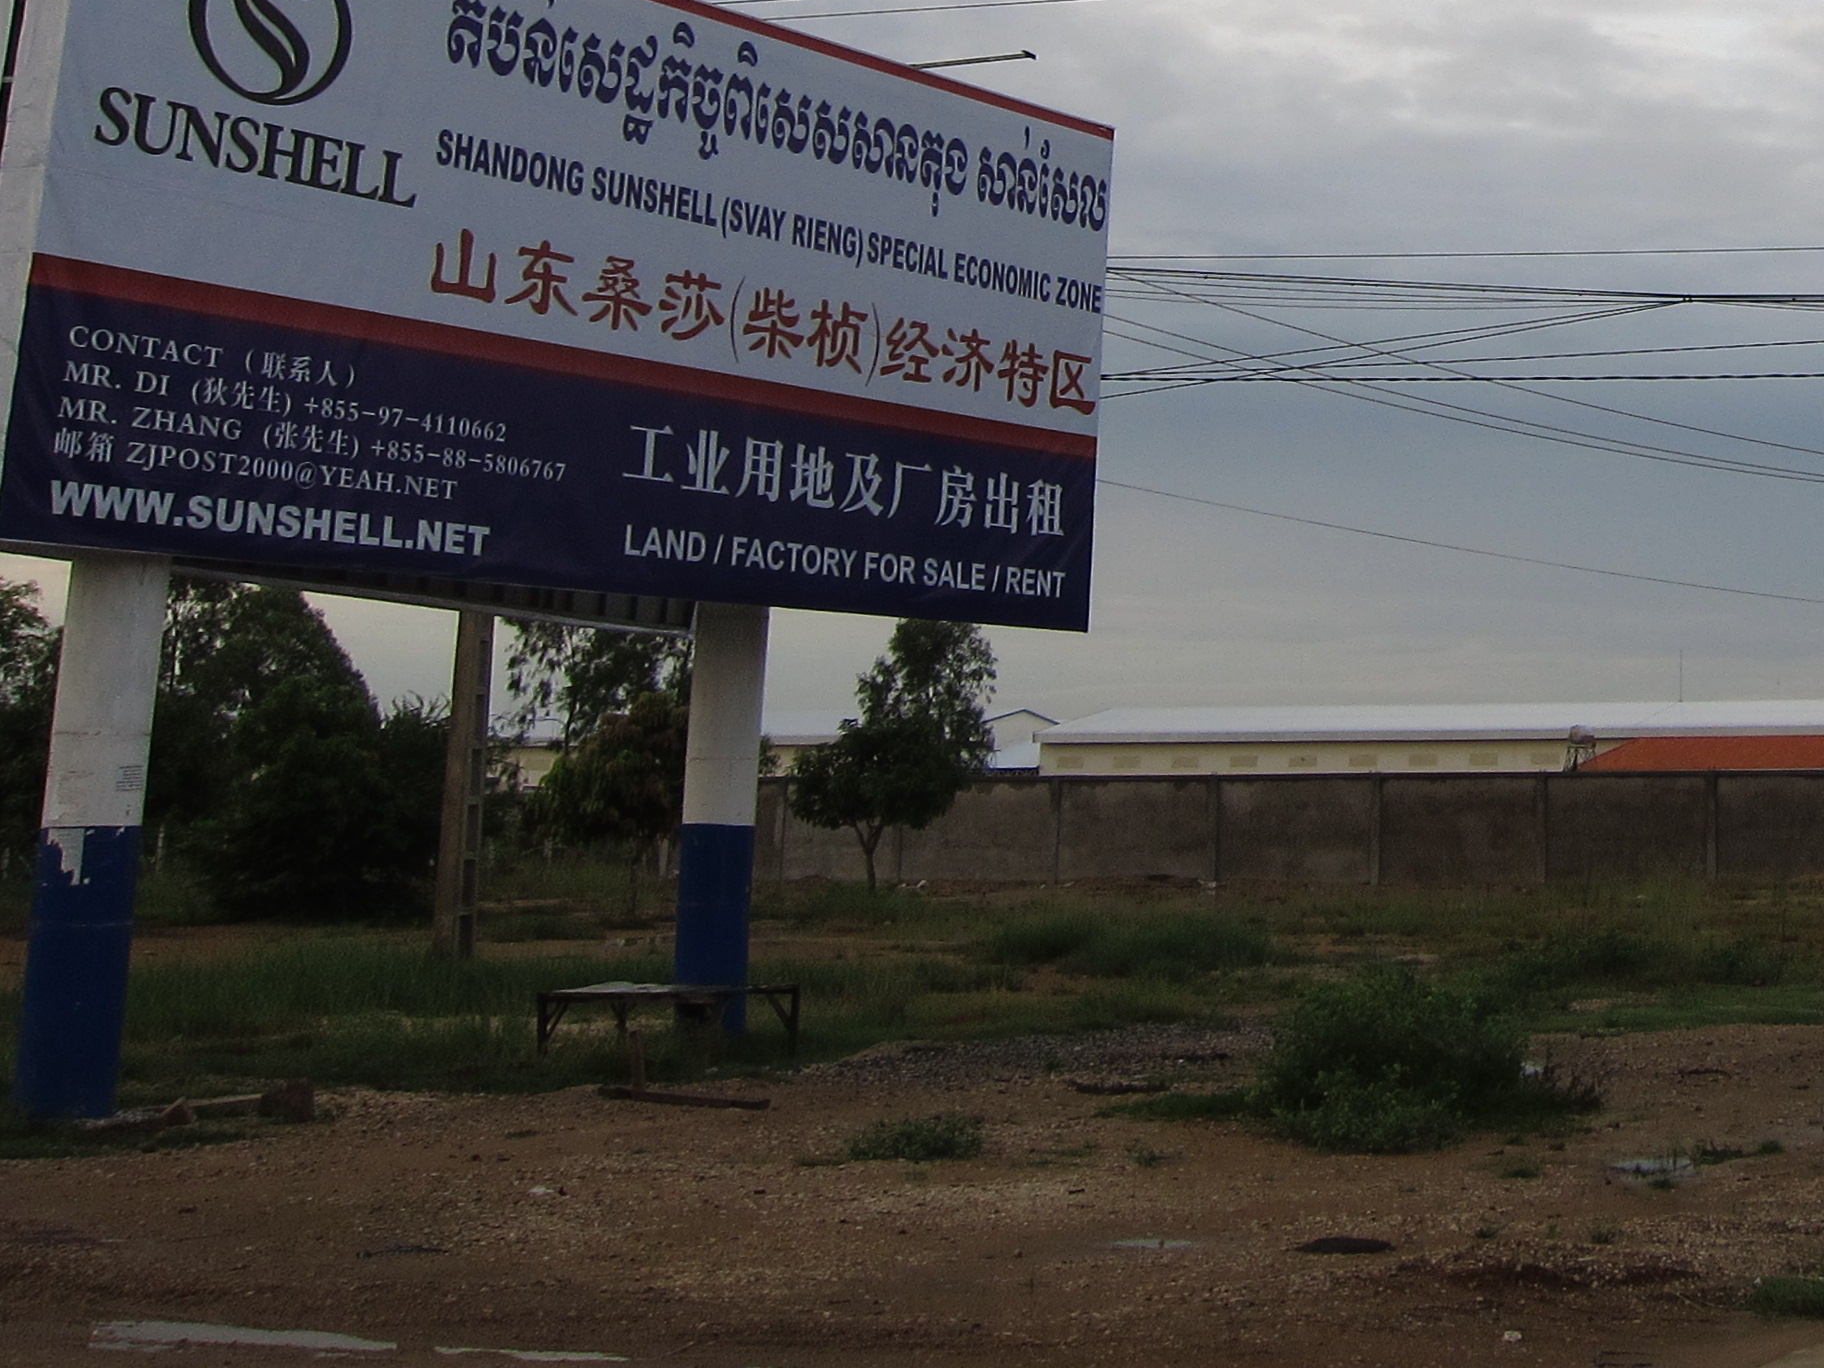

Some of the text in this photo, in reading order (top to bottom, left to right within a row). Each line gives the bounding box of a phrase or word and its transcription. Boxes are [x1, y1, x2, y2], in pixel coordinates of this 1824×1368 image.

[94, 87, 417, 208] SUNSHELL
[436, 129, 1102, 314] SHANDONG SUNSHELL (SVAY RIENG) SPECIAL ECONOMIC ZONE
[69, 325, 223, 368] CONTACT
[57, 396, 117, 425] MR.
[132, 406, 242, 441] ZHANG
[370, 439, 567, 482] +855-88-5806767
[63, 360, 121, 390] MR.
[134, 370, 170, 397] DI
[304, 396, 507, 443] +855-97-4110662
[54, 427, 459, 500] 邮箱 ZJPOST2000@YEAH.NET
[622, 425, 1065, 536] 工业用地及厂房出租
[51, 479, 491, 557] WWW.SUNSHELL.NET
[624, 523, 1066, 599] LAND / FACTORY FOR SALE / RENT
